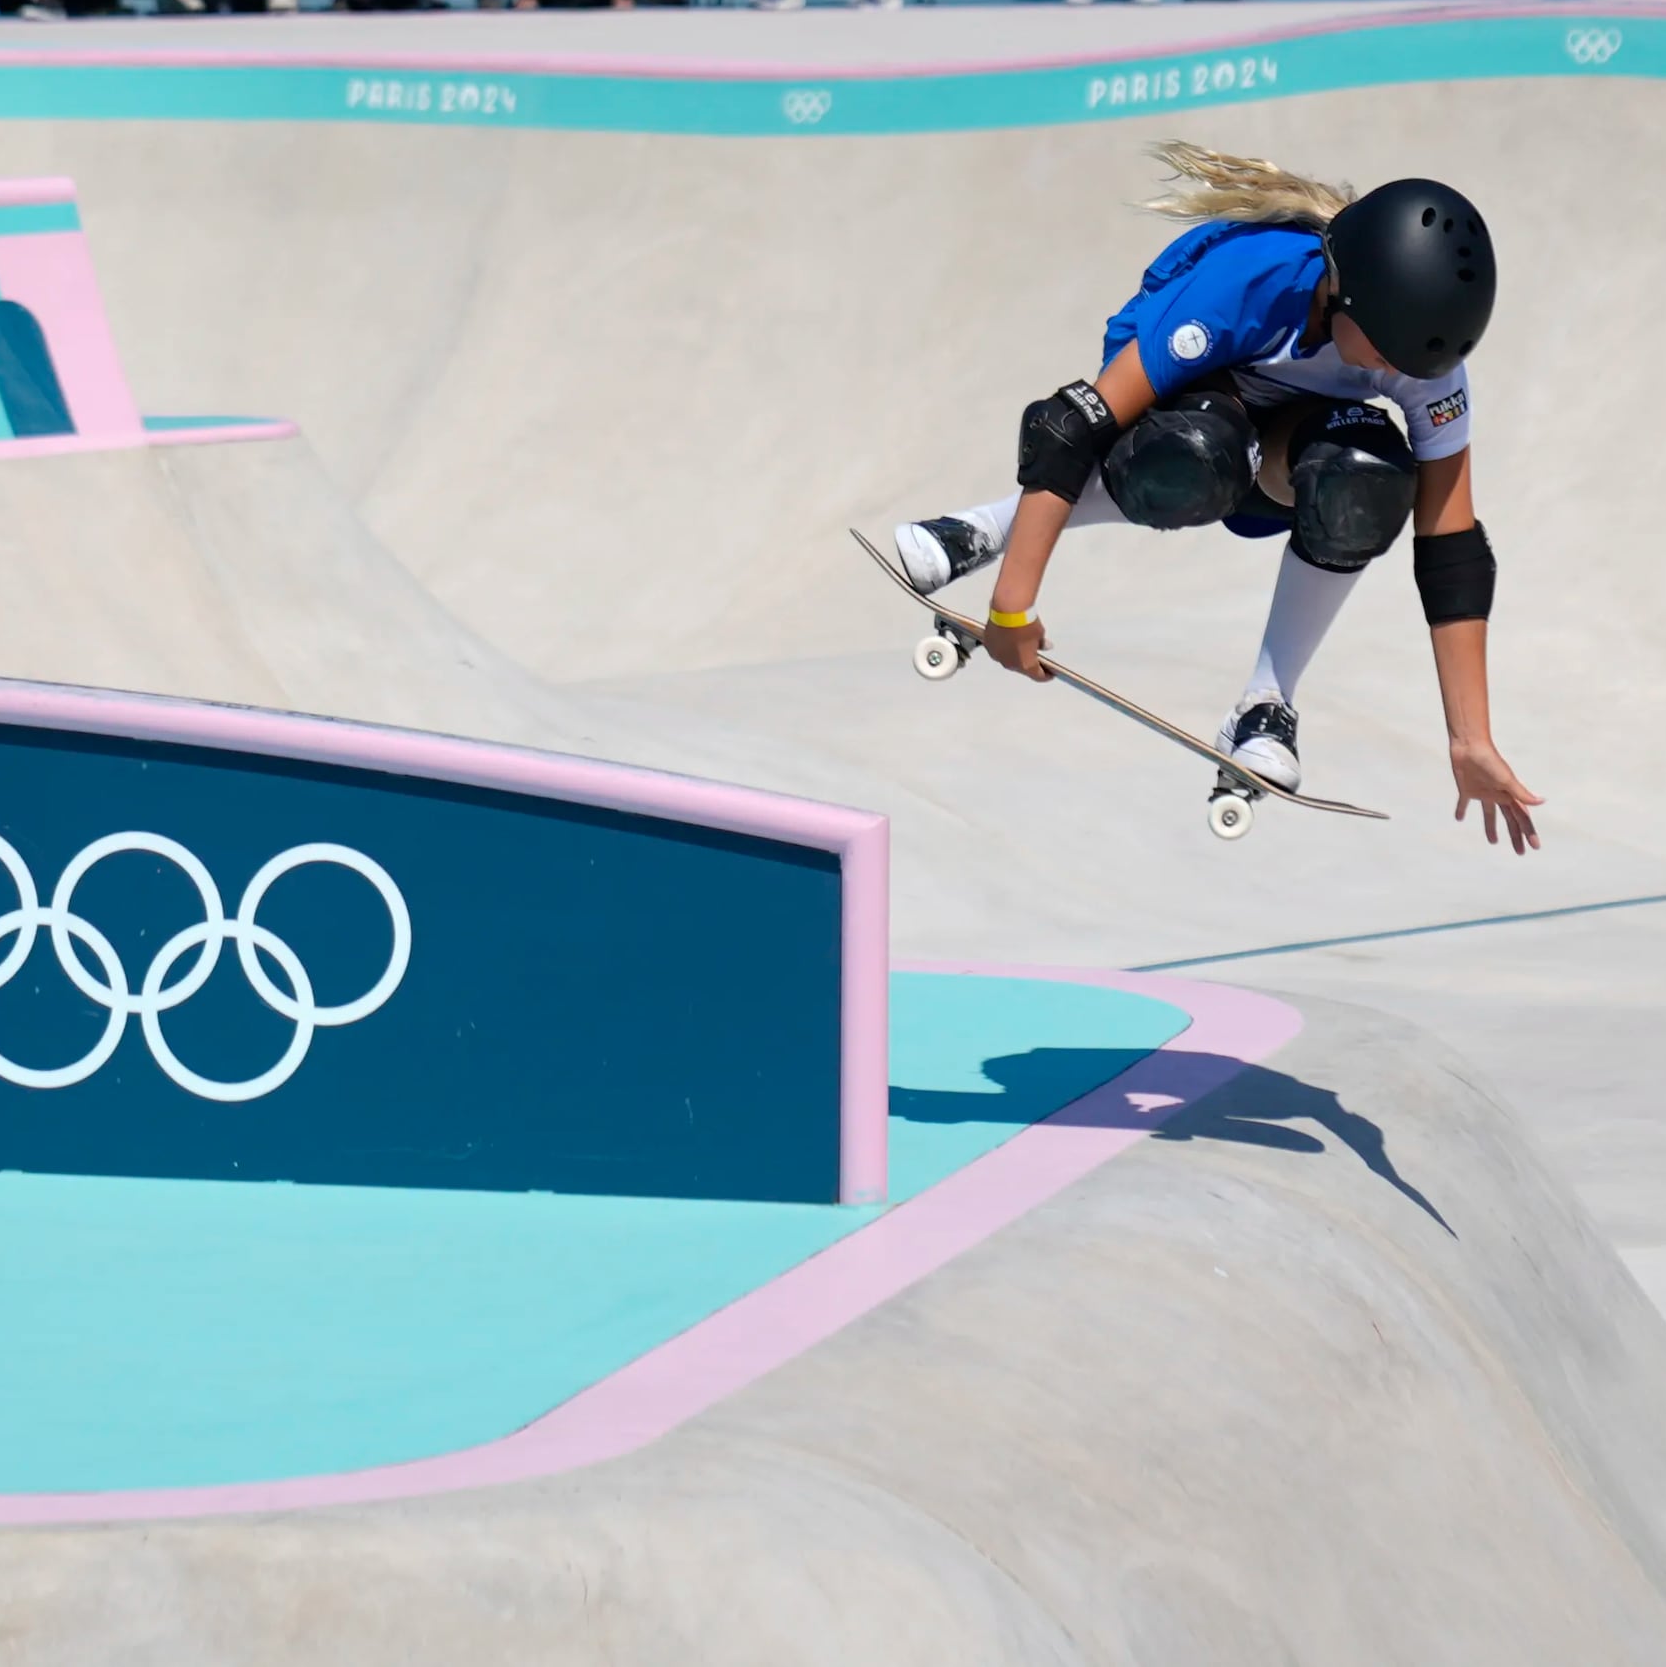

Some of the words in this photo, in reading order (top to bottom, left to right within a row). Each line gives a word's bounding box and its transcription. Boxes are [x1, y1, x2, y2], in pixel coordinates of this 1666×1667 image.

[1192, 56, 1277, 95] 2024
[440, 84, 517, 113] 2024
[1075, 385, 1107, 417] 187
[1429, 392, 1465, 417] rukka
